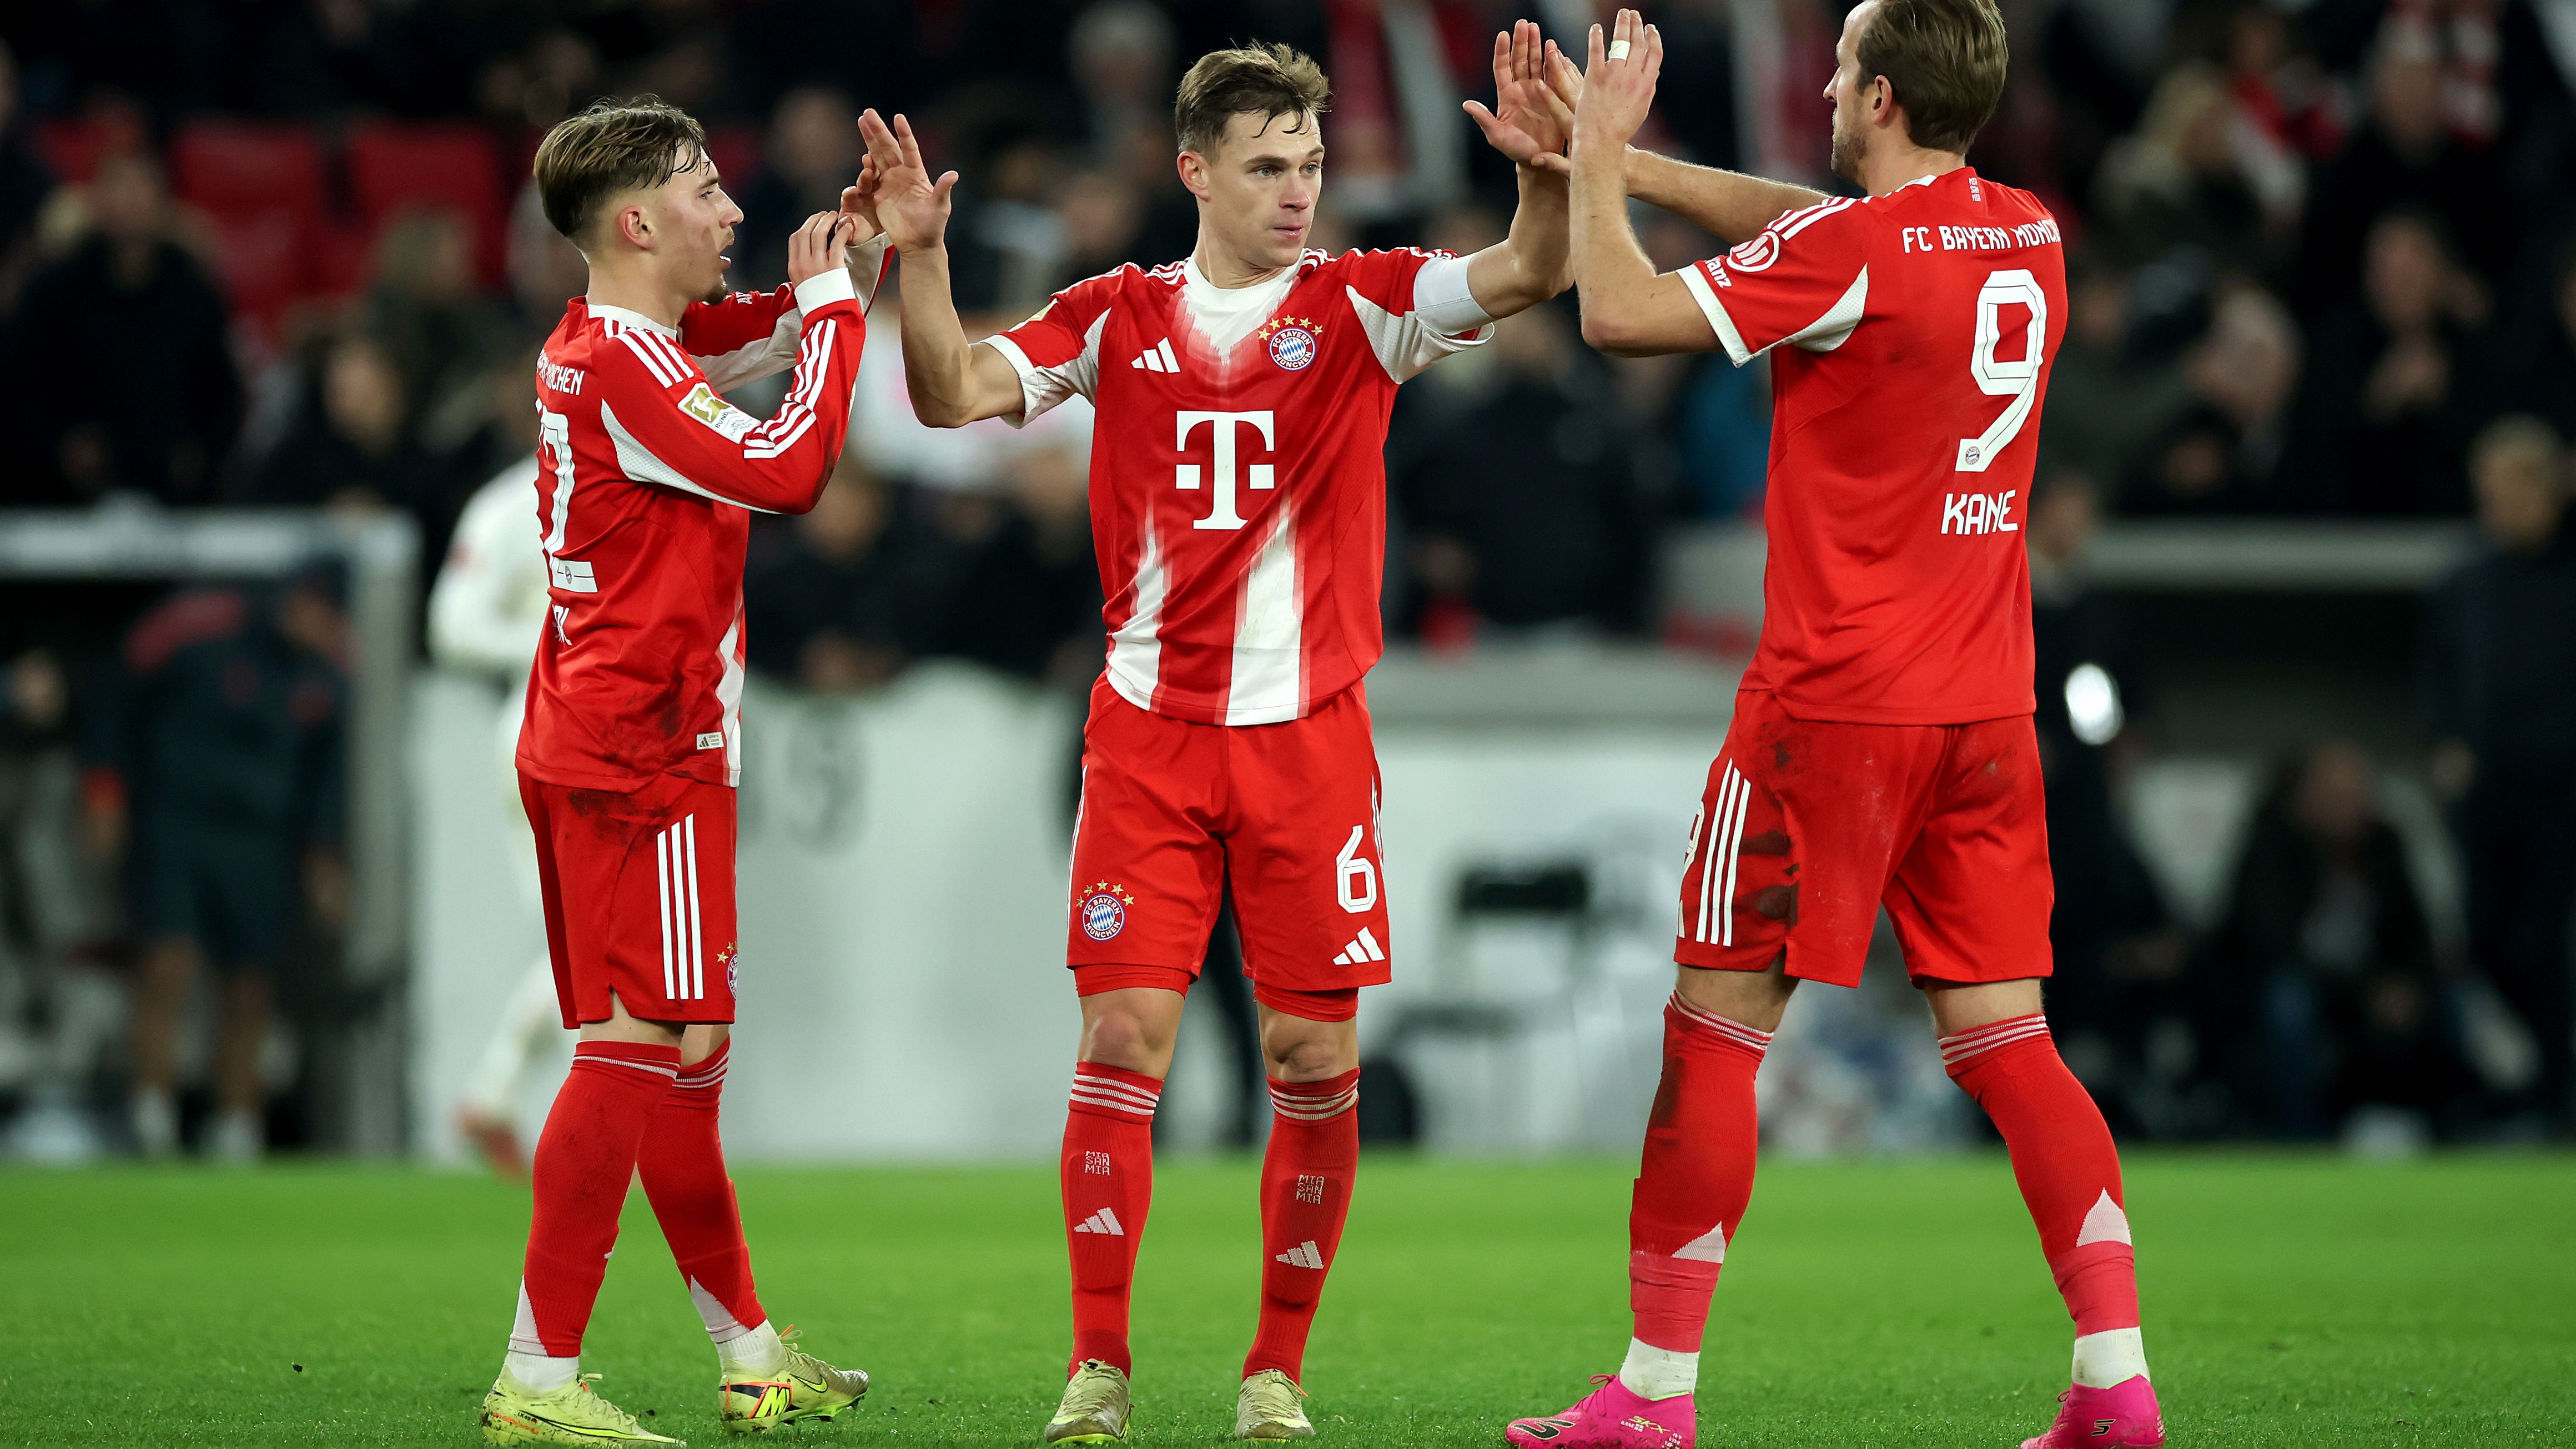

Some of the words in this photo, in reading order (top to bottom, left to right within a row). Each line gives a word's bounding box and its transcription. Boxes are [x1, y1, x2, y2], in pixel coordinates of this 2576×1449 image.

[1902, 227, 1933, 253] FC
[1938, 225, 2011, 250] BAYERN
[1272, 338, 1281, 348] FC
[1280, 330, 1311, 345] BAYERN
[1955, 269, 2047, 472] 9
[1175, 410, 1275, 530] T
[1941, 489, 2019, 535] KANE
[1336, 824, 1377, 914] 6
[1085, 904, 1093, 915] FC
[1093, 897, 1121, 914] BAYERN
[1085, 1156, 1110, 1167] SAN
[1085, 1164, 1110, 1176] MIA
[1297, 1182, 1323, 1195] SAN
[1298, 1174, 1325, 1185] MIA
[1296, 1190, 1321, 1205] MIA
